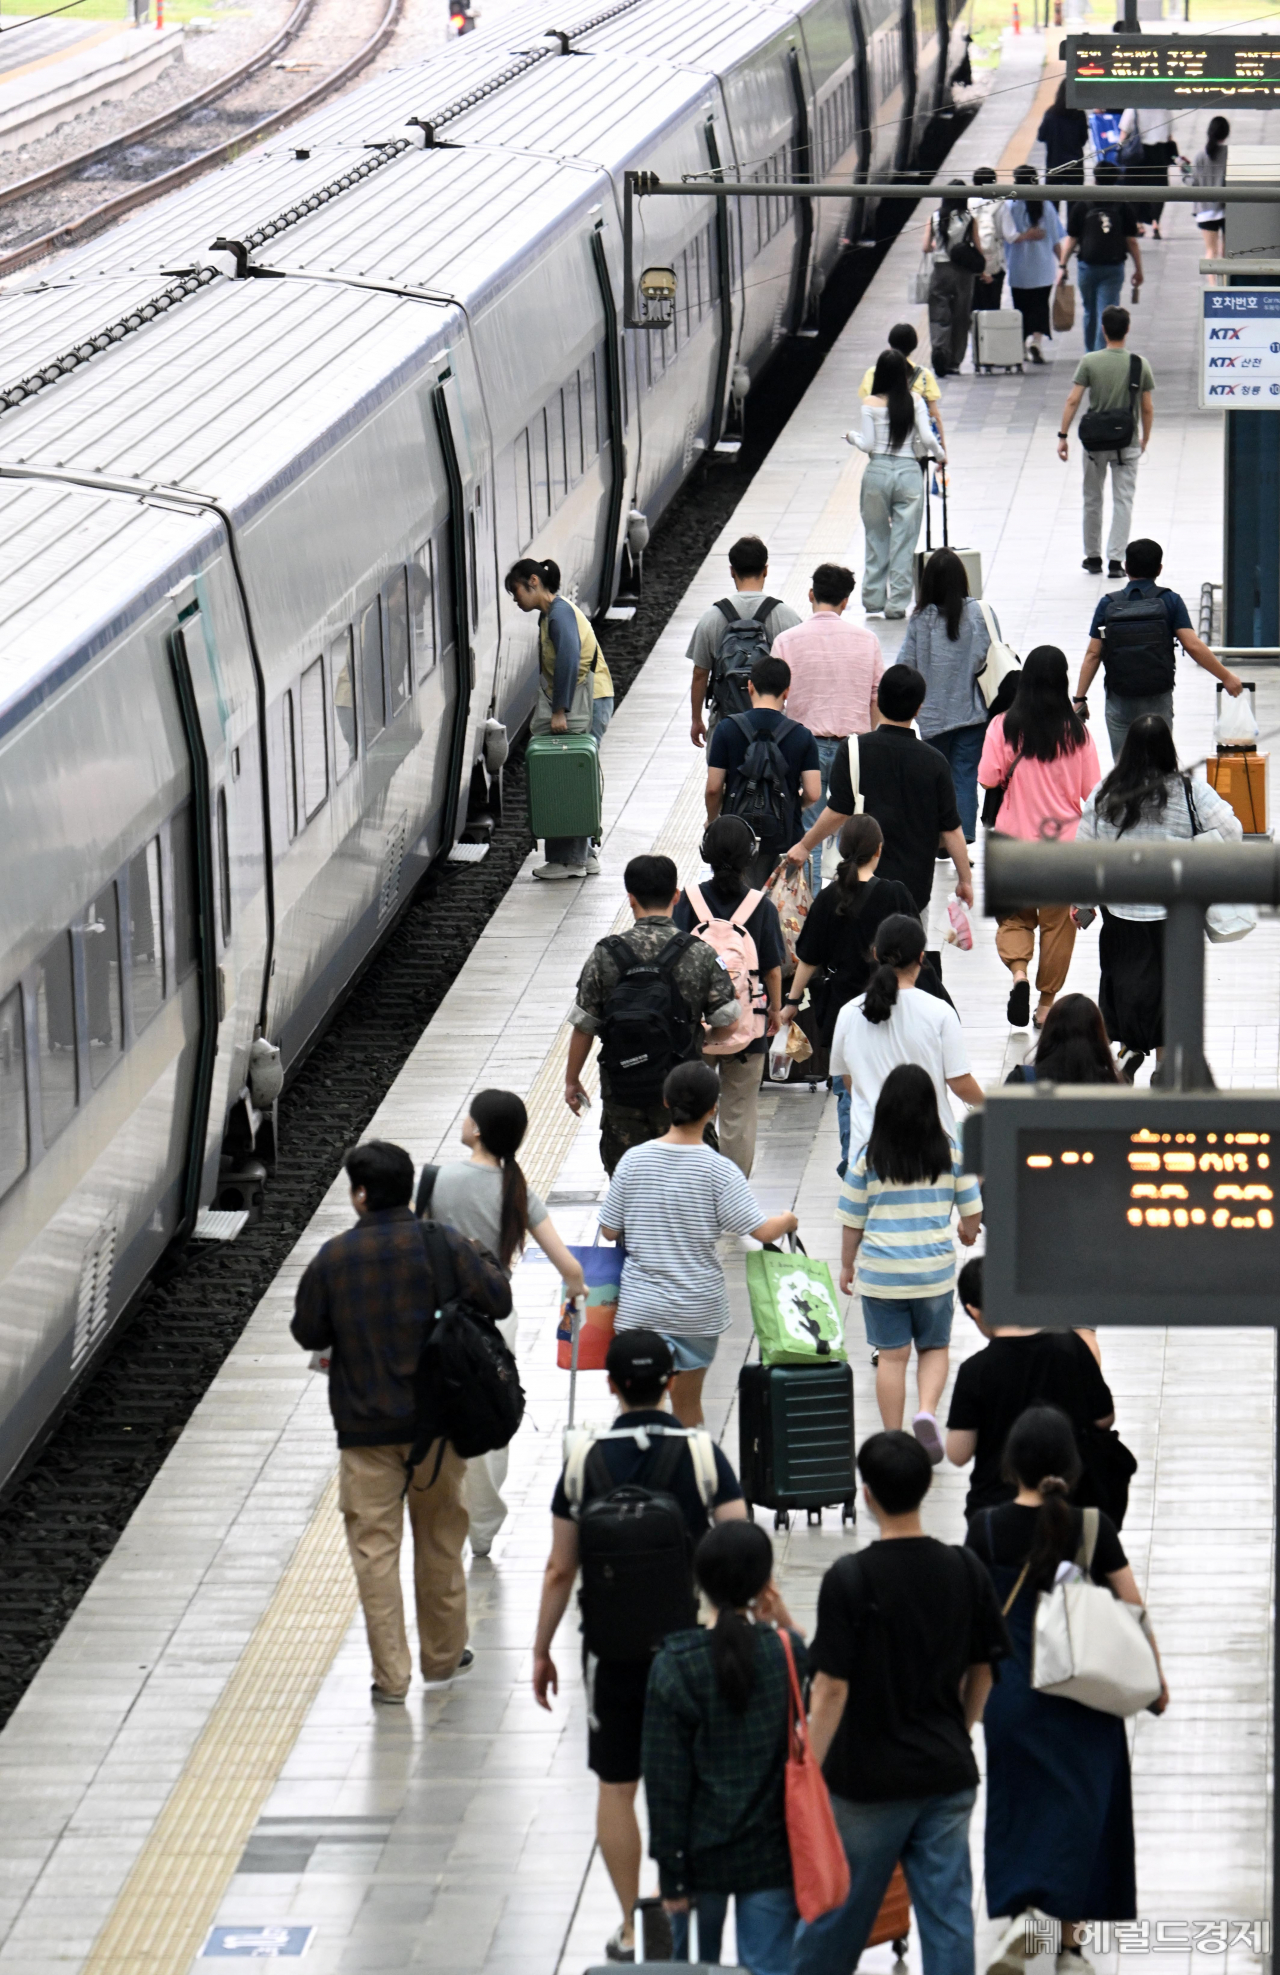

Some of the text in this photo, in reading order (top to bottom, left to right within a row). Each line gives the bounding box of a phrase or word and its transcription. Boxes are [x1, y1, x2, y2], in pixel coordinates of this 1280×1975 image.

[1212, 296, 1258, 310] 호차번호
[1209, 326, 1247, 340] KTX
[1208, 356, 1262, 368] KTX 산천
[1208, 384, 1261, 396] KTX 청룡
